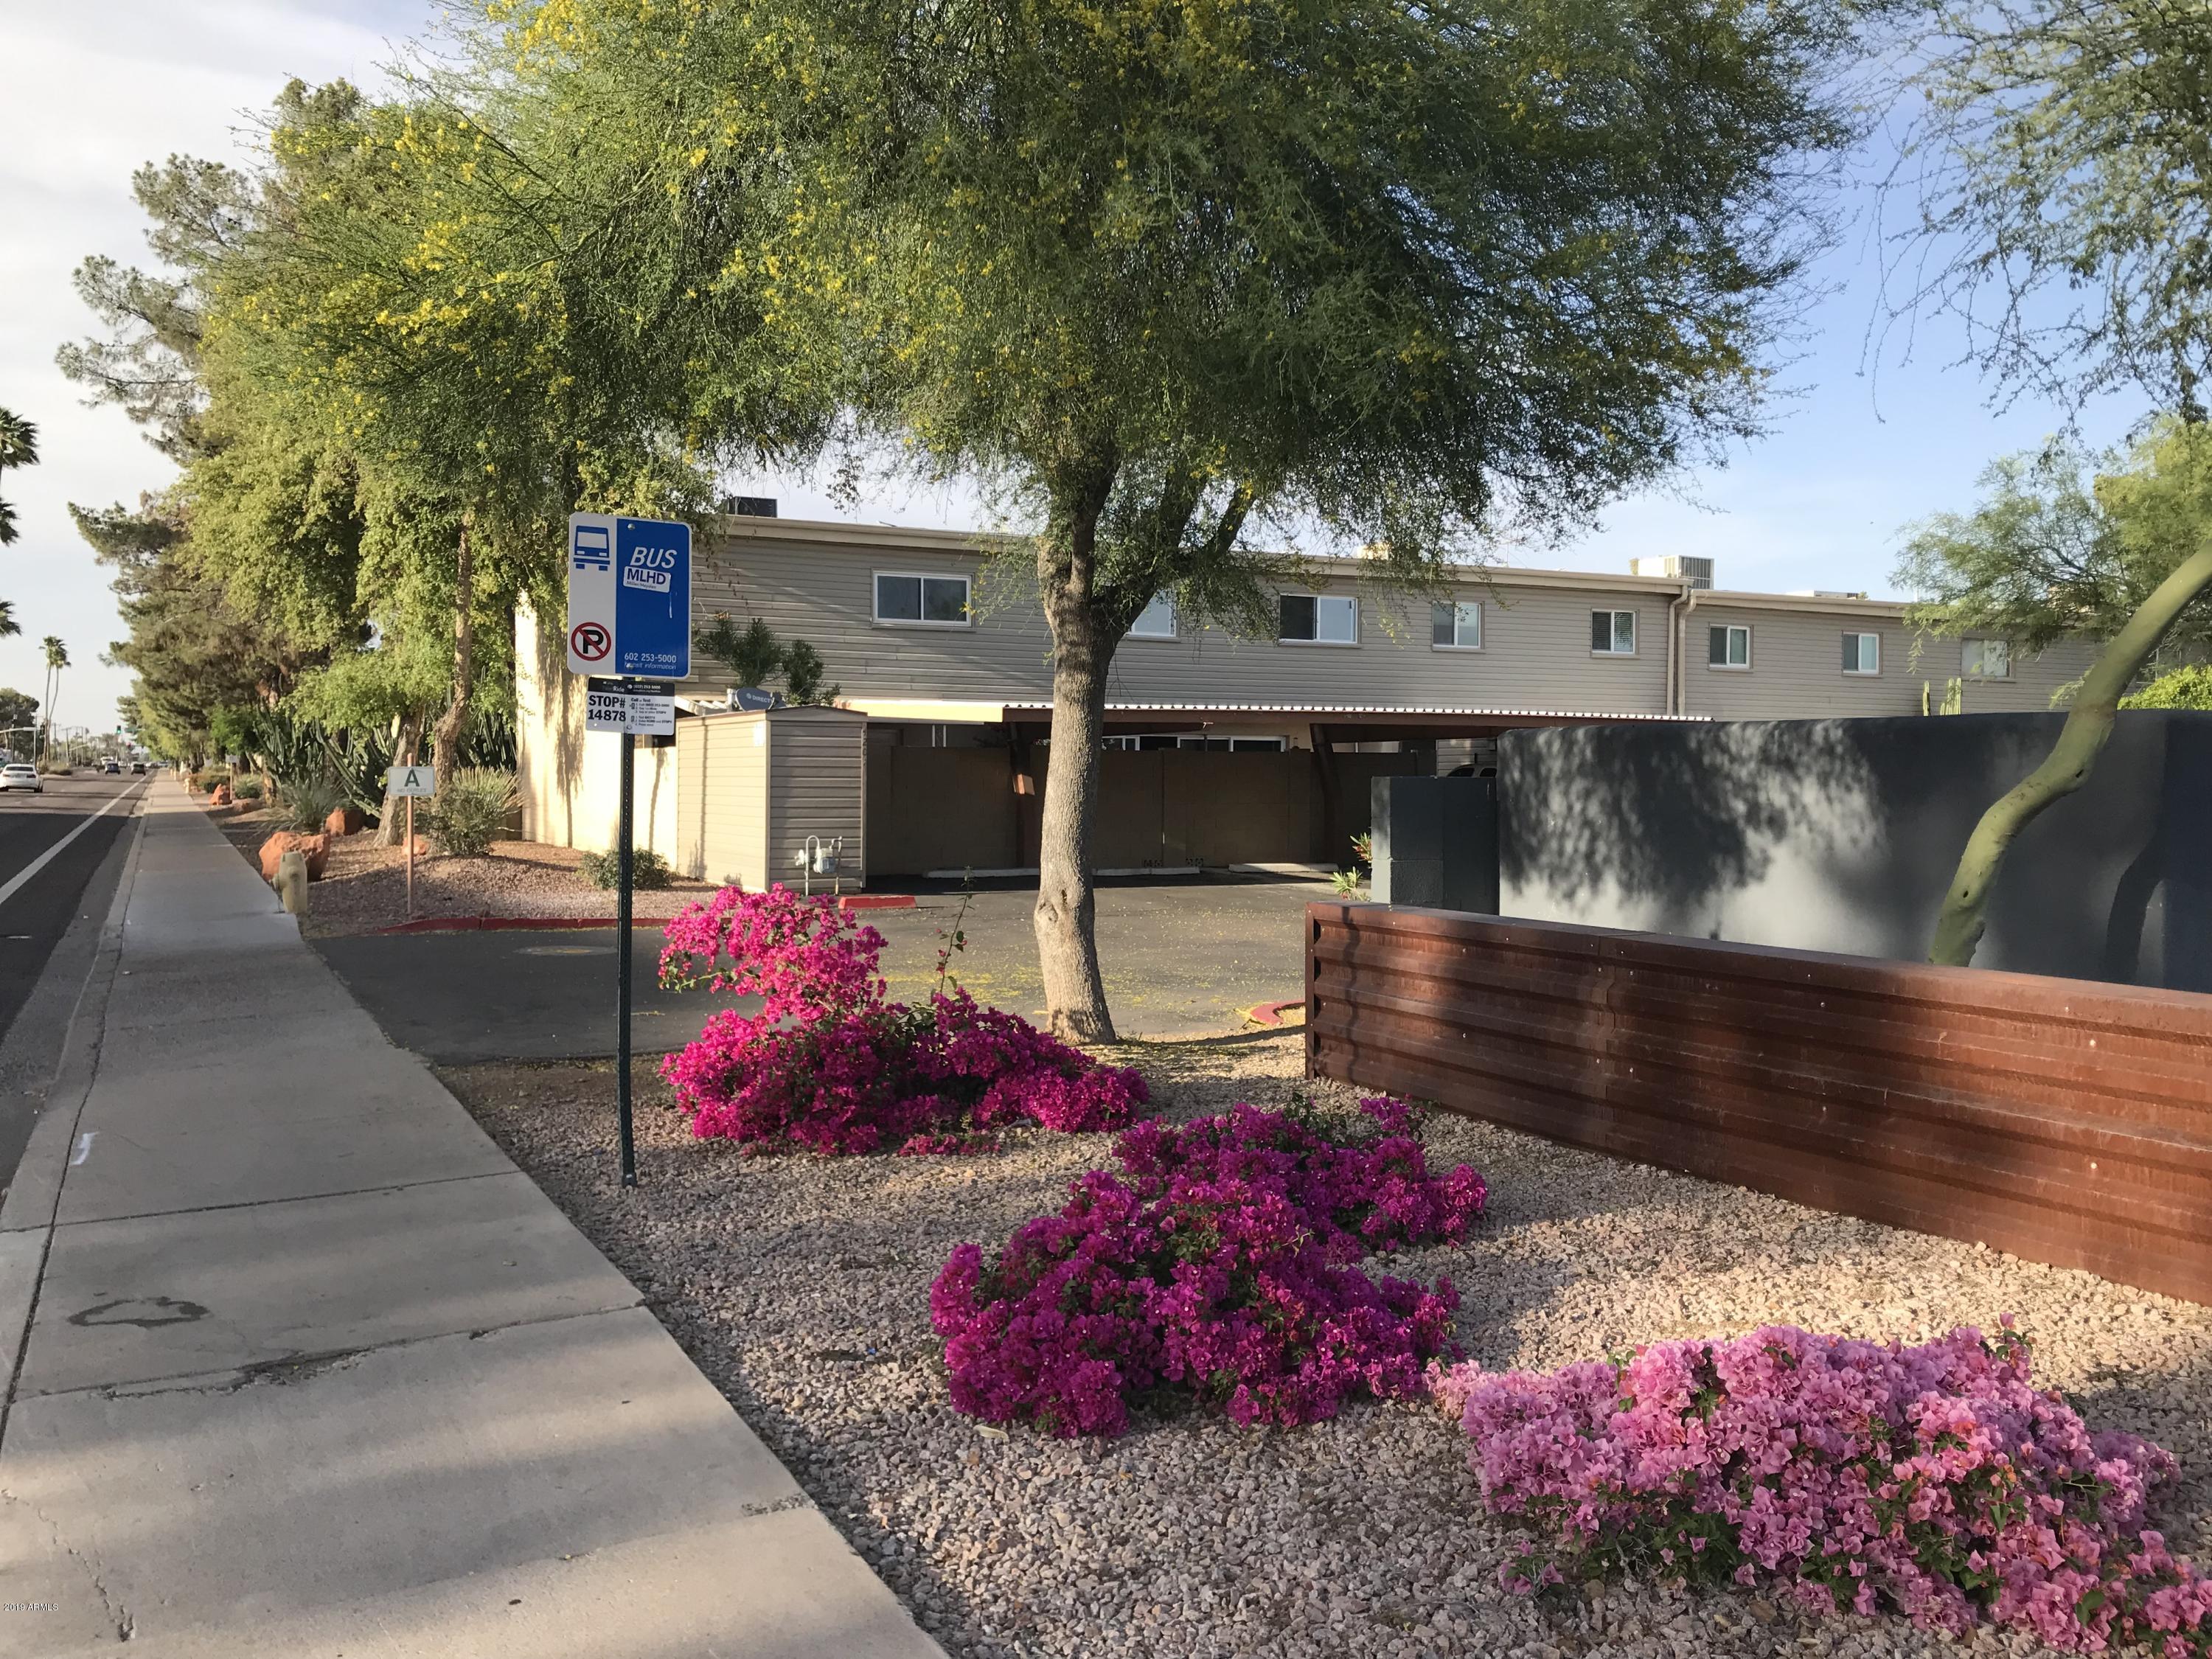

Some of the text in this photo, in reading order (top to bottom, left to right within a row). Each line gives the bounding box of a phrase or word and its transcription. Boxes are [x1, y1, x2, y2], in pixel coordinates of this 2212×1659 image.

[630, 546, 678, 568] BUS
[627, 568, 667, 585] MLHD
[625, 653, 677, 663] 602 253-5000
[588, 695, 625, 708] STOP#
[588, 709, 626, 722] 14878
[404, 768, 420, 787] A
